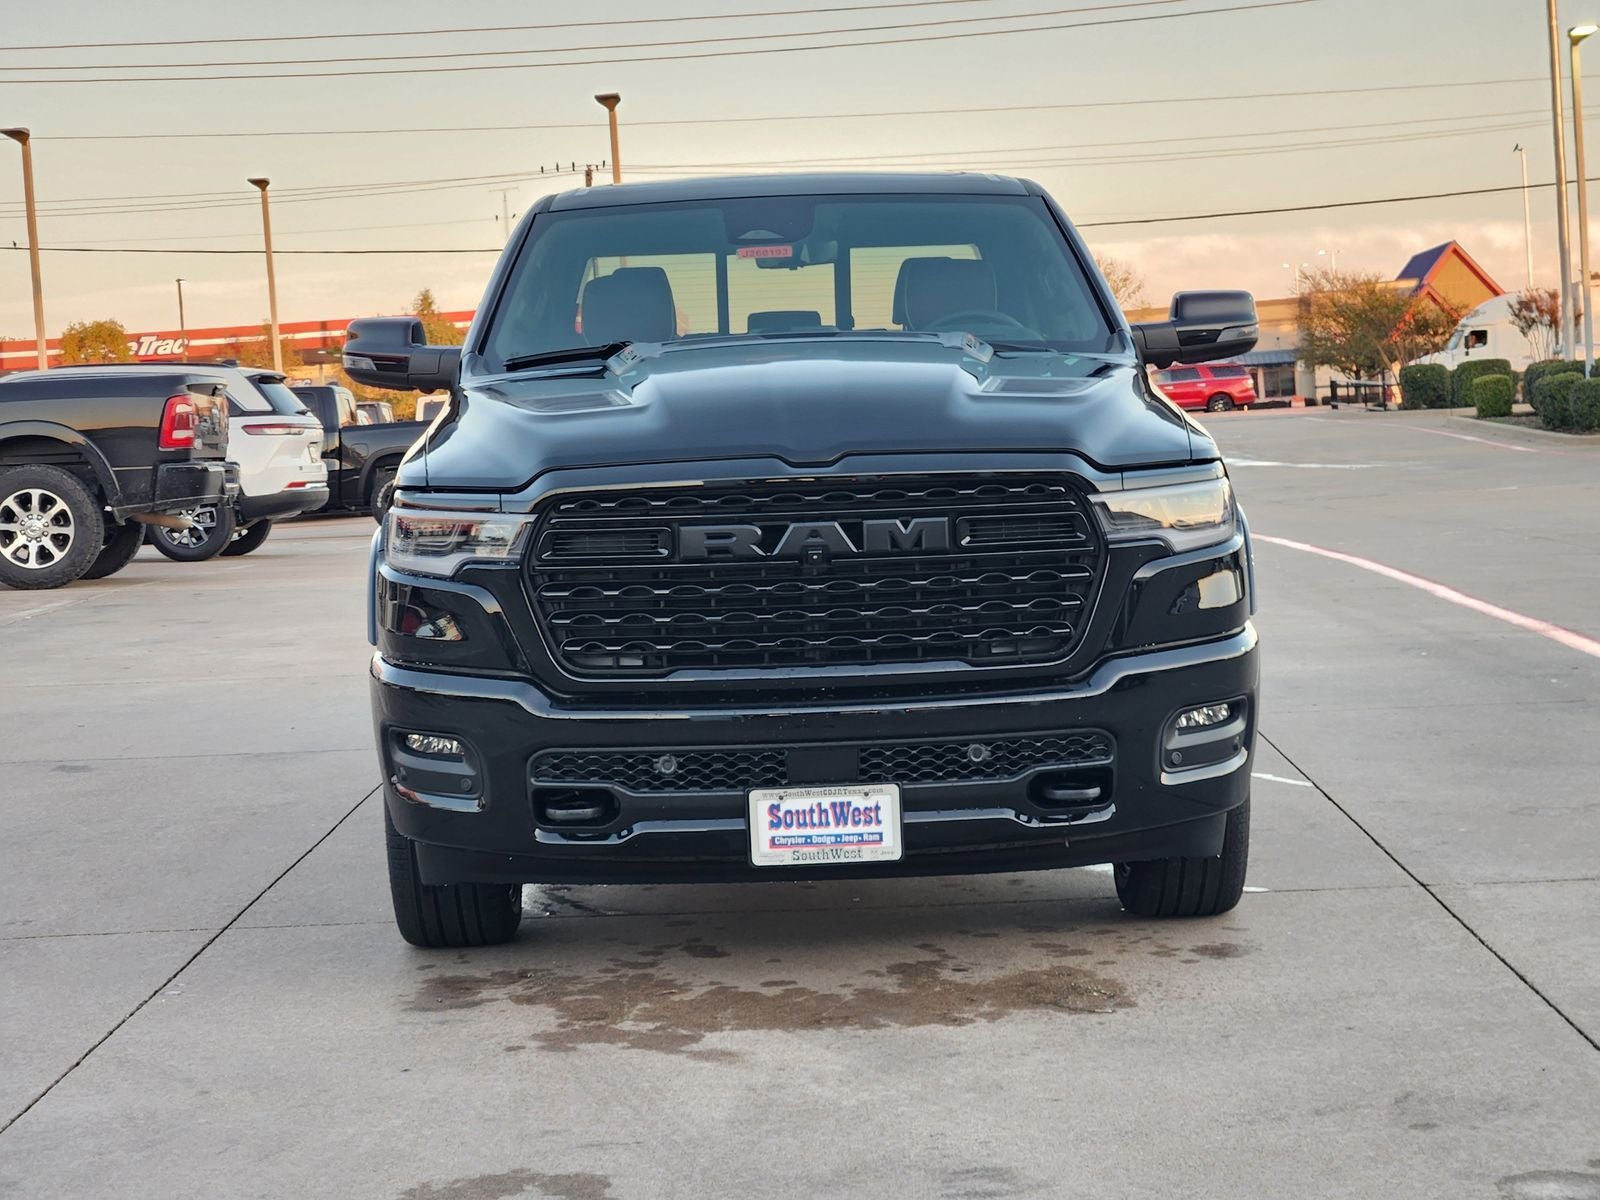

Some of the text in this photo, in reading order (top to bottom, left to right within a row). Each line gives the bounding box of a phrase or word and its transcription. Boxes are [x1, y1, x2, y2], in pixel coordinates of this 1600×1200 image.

[127, 335, 189, 356] eTrac
[679, 517, 949, 559] RAM
[767, 800, 882, 830] SouthWest
[774, 833, 880, 846] Chrysler Dodge Jeep Ram
[792, 847, 863, 862] SouthWest
